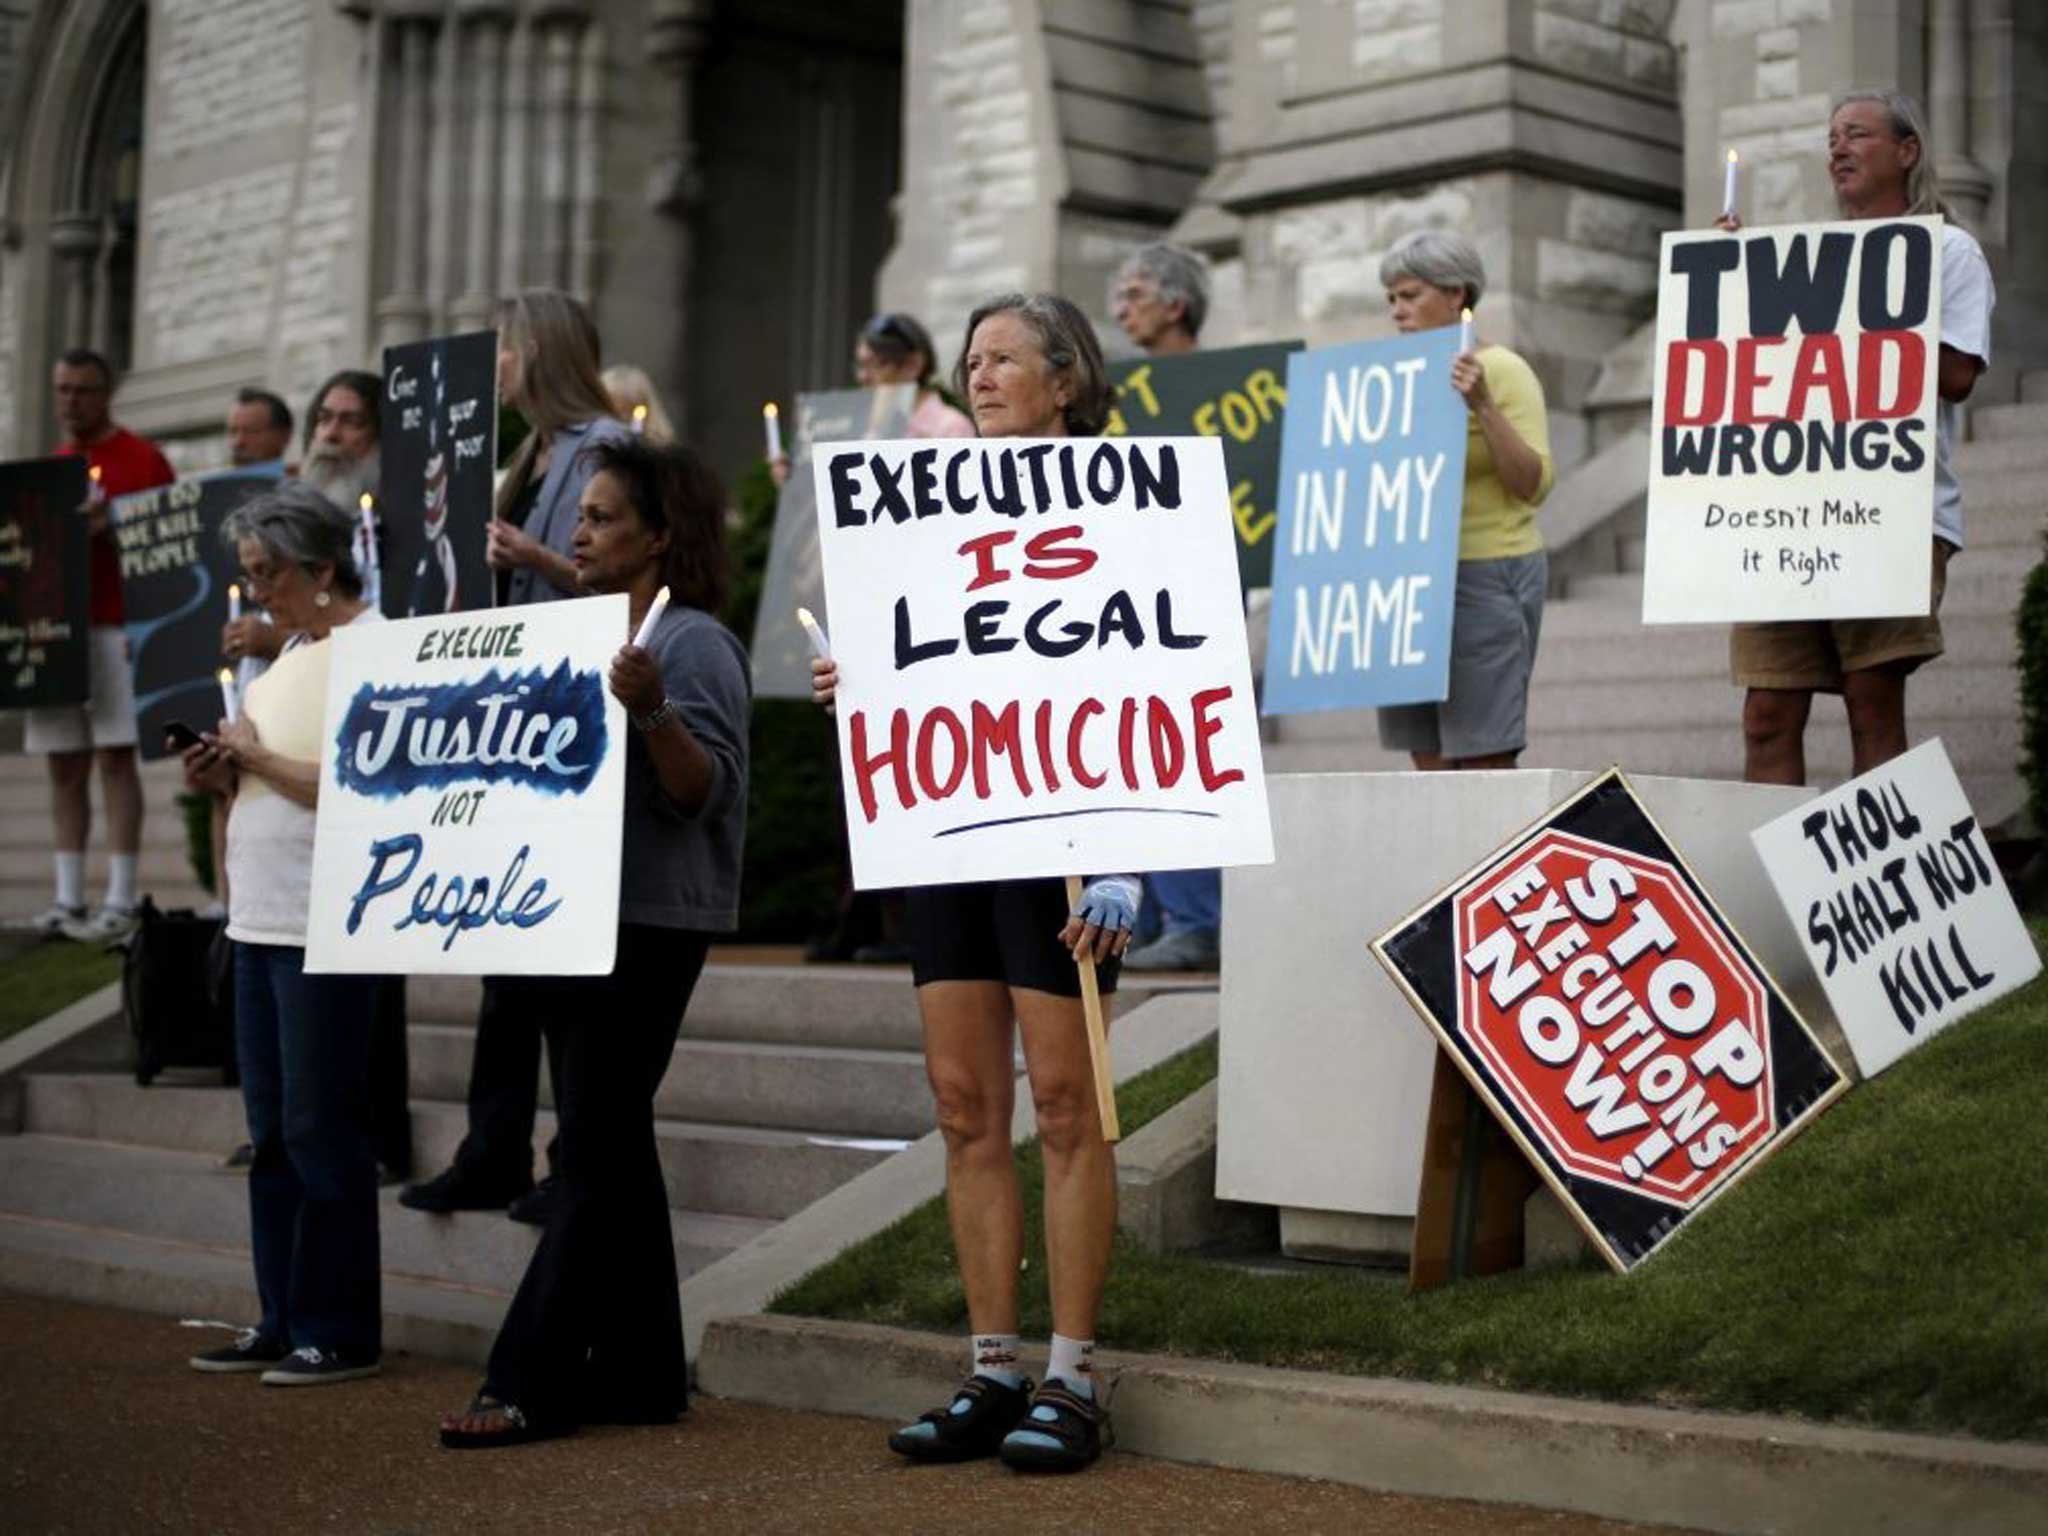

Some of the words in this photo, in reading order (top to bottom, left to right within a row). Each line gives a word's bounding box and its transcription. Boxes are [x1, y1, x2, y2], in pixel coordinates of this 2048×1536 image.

[1670, 222, 1933, 340] TWO
[448, 398, 478, 436] your
[1192, 369, 1289, 443] FOR
[1322, 357, 1427, 448] NOT
[1664, 330, 1926, 428] DEAD
[829, 442, 1182, 529] EXECUTION
[1662, 419, 1926, 477] WRONGS
[1292, 467, 1347, 556] IN
[1365, 453, 1445, 548] MY
[1705, 503, 1810, 529] Doesn't
[1821, 500, 1884, 527] Make
[120, 537, 201, 578] PEOPLE
[957, 525, 1099, 593] IS
[1779, 548, 1842, 586] Right
[416, 622, 525, 663] EXECUTE
[894, 588, 1208, 671] LEGAL
[1291, 575, 1431, 677] NAME
[355, 685, 590, 776] Justice
[850, 685, 1245, 824] HOMICIDE
[431, 790, 486, 827] NOT
[1802, 779, 1921, 874] THOU
[346, 833, 563, 952] People
[1808, 857, 1920, 978] SHALT
[1916, 816, 1992, 910] NOT
[1492, 861, 1739, 1170] EXECUTIONS
[1564, 857, 1766, 1088] STOP
[1879, 922, 1995, 1035] KILL
[1463, 925, 1676, 1181] NOW!
